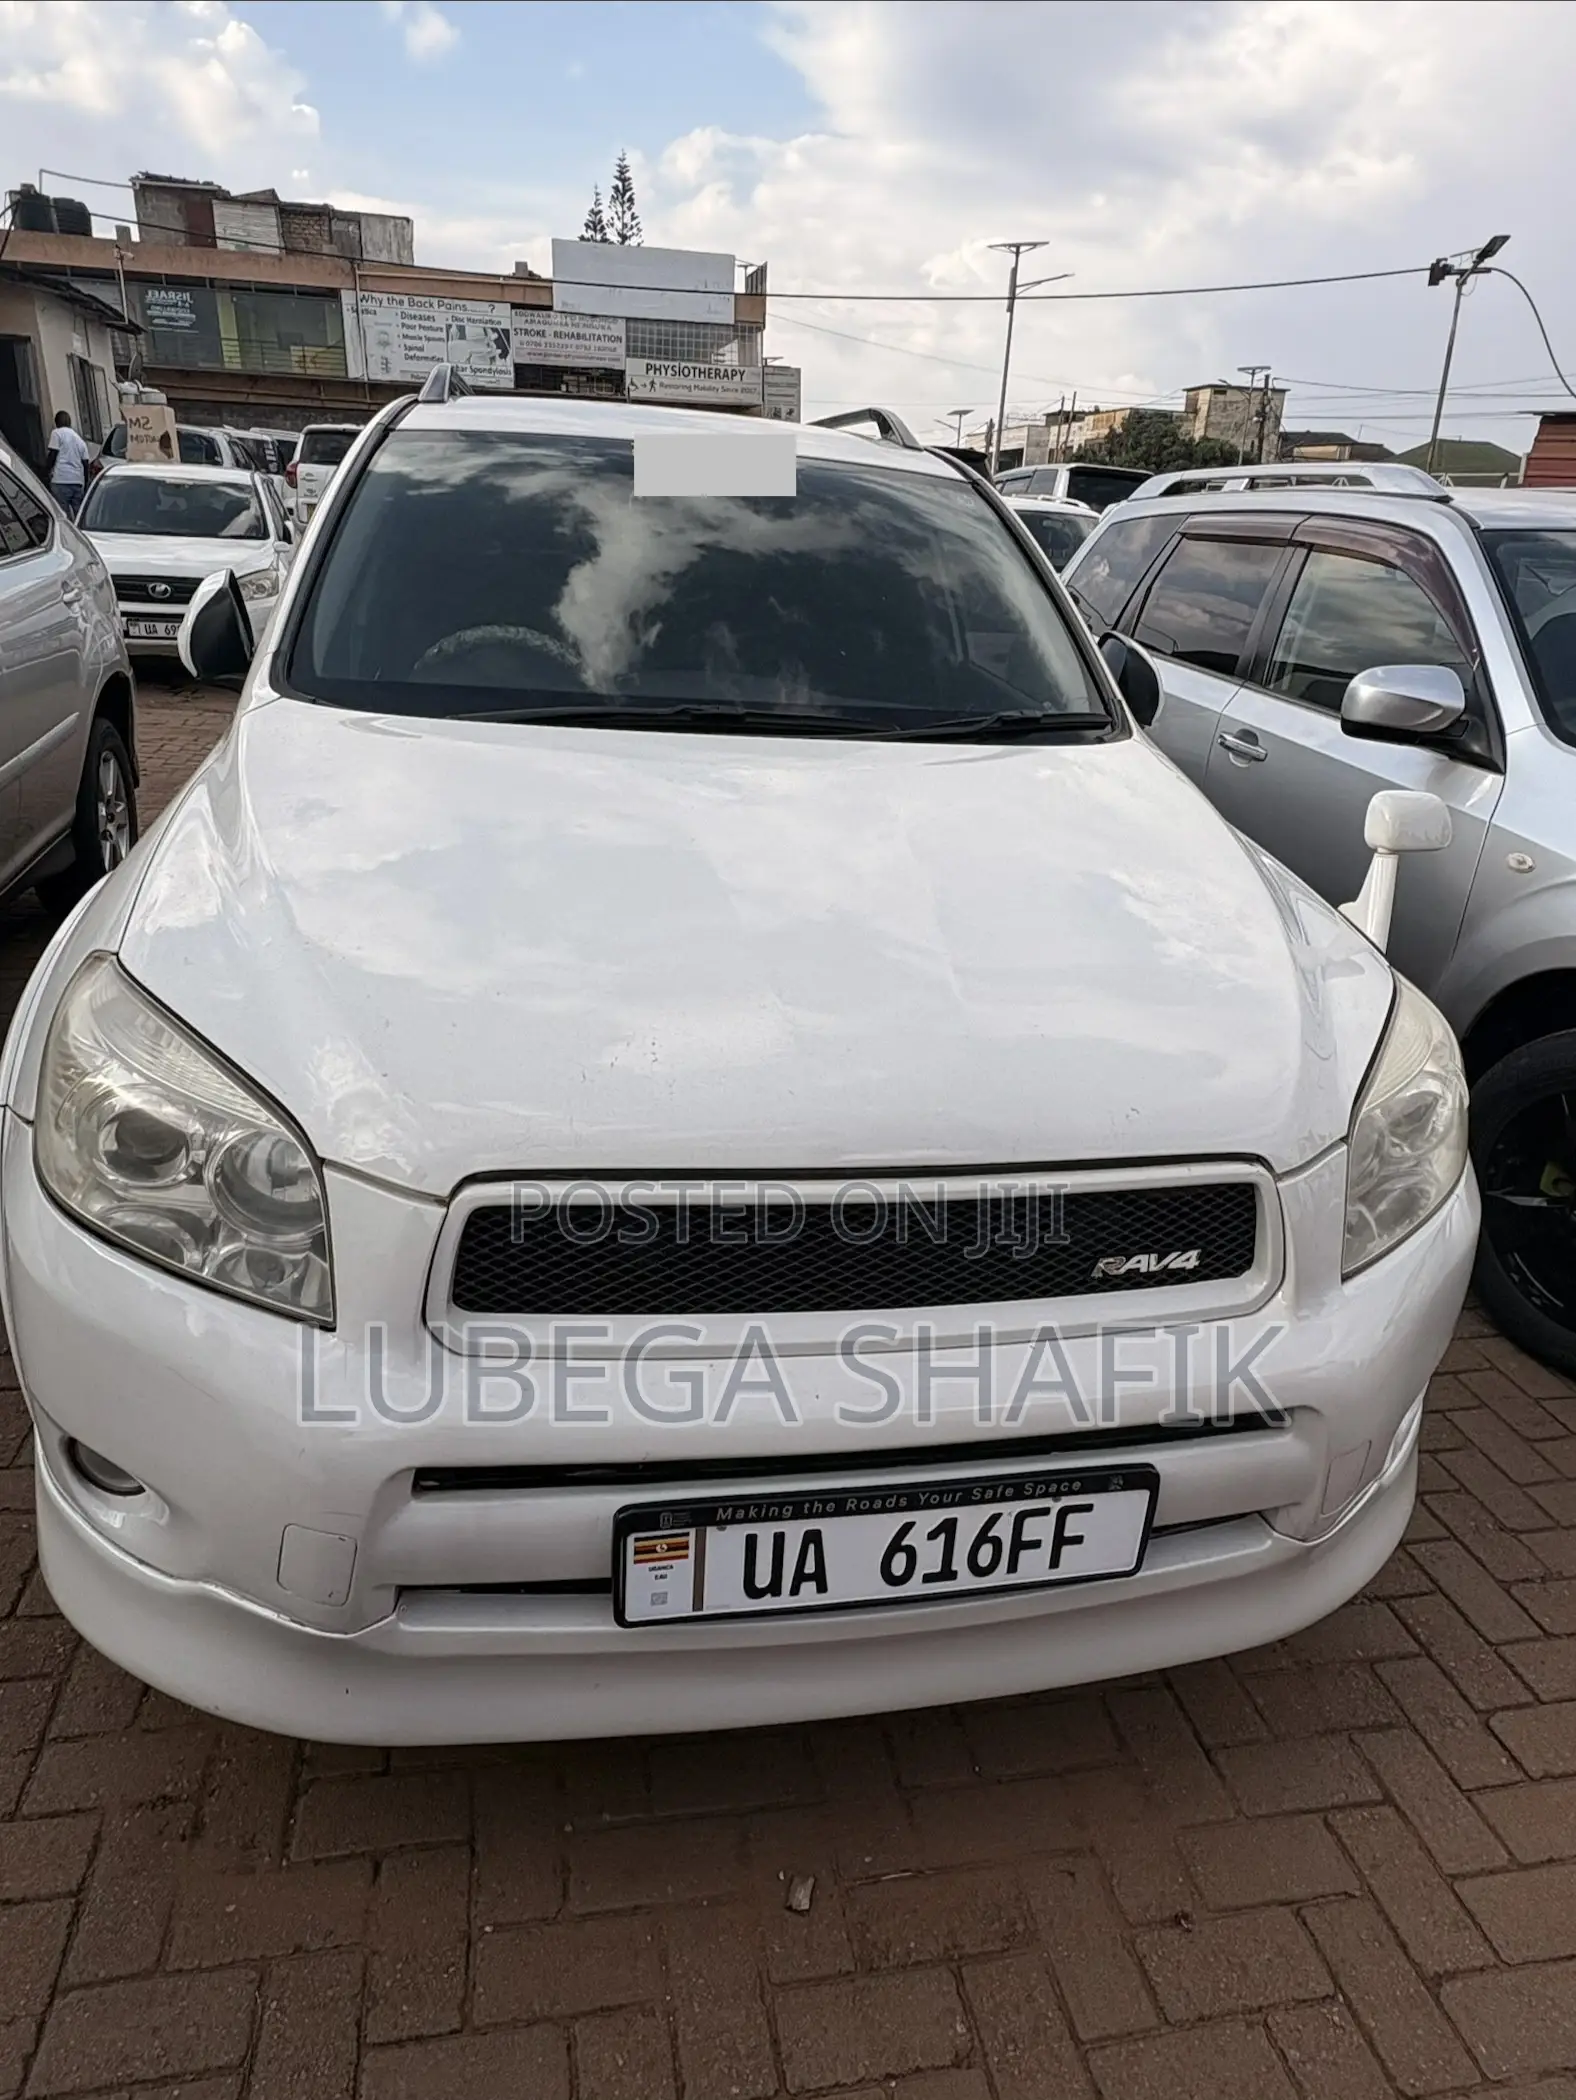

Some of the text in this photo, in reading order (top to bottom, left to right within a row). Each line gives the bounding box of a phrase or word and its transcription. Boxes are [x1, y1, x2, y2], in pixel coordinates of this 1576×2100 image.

[361, 294, 383, 308] Why
[387, 296, 404, 306] the
[408, 297, 434, 309] Back
[401, 311, 435, 322] Diseases
[514, 328, 547, 338] STROKE
[553, 330, 623, 344] REHABILITATION
[404, 343, 424, 354] Spinal
[144, 623, 158, 635] UA
[1091, 1249, 1202, 1278] RAV4
[716, 1480, 1082, 1522] Making the Roads Your Safe Space
[743, 1503, 1095, 1599] UA 616FF
